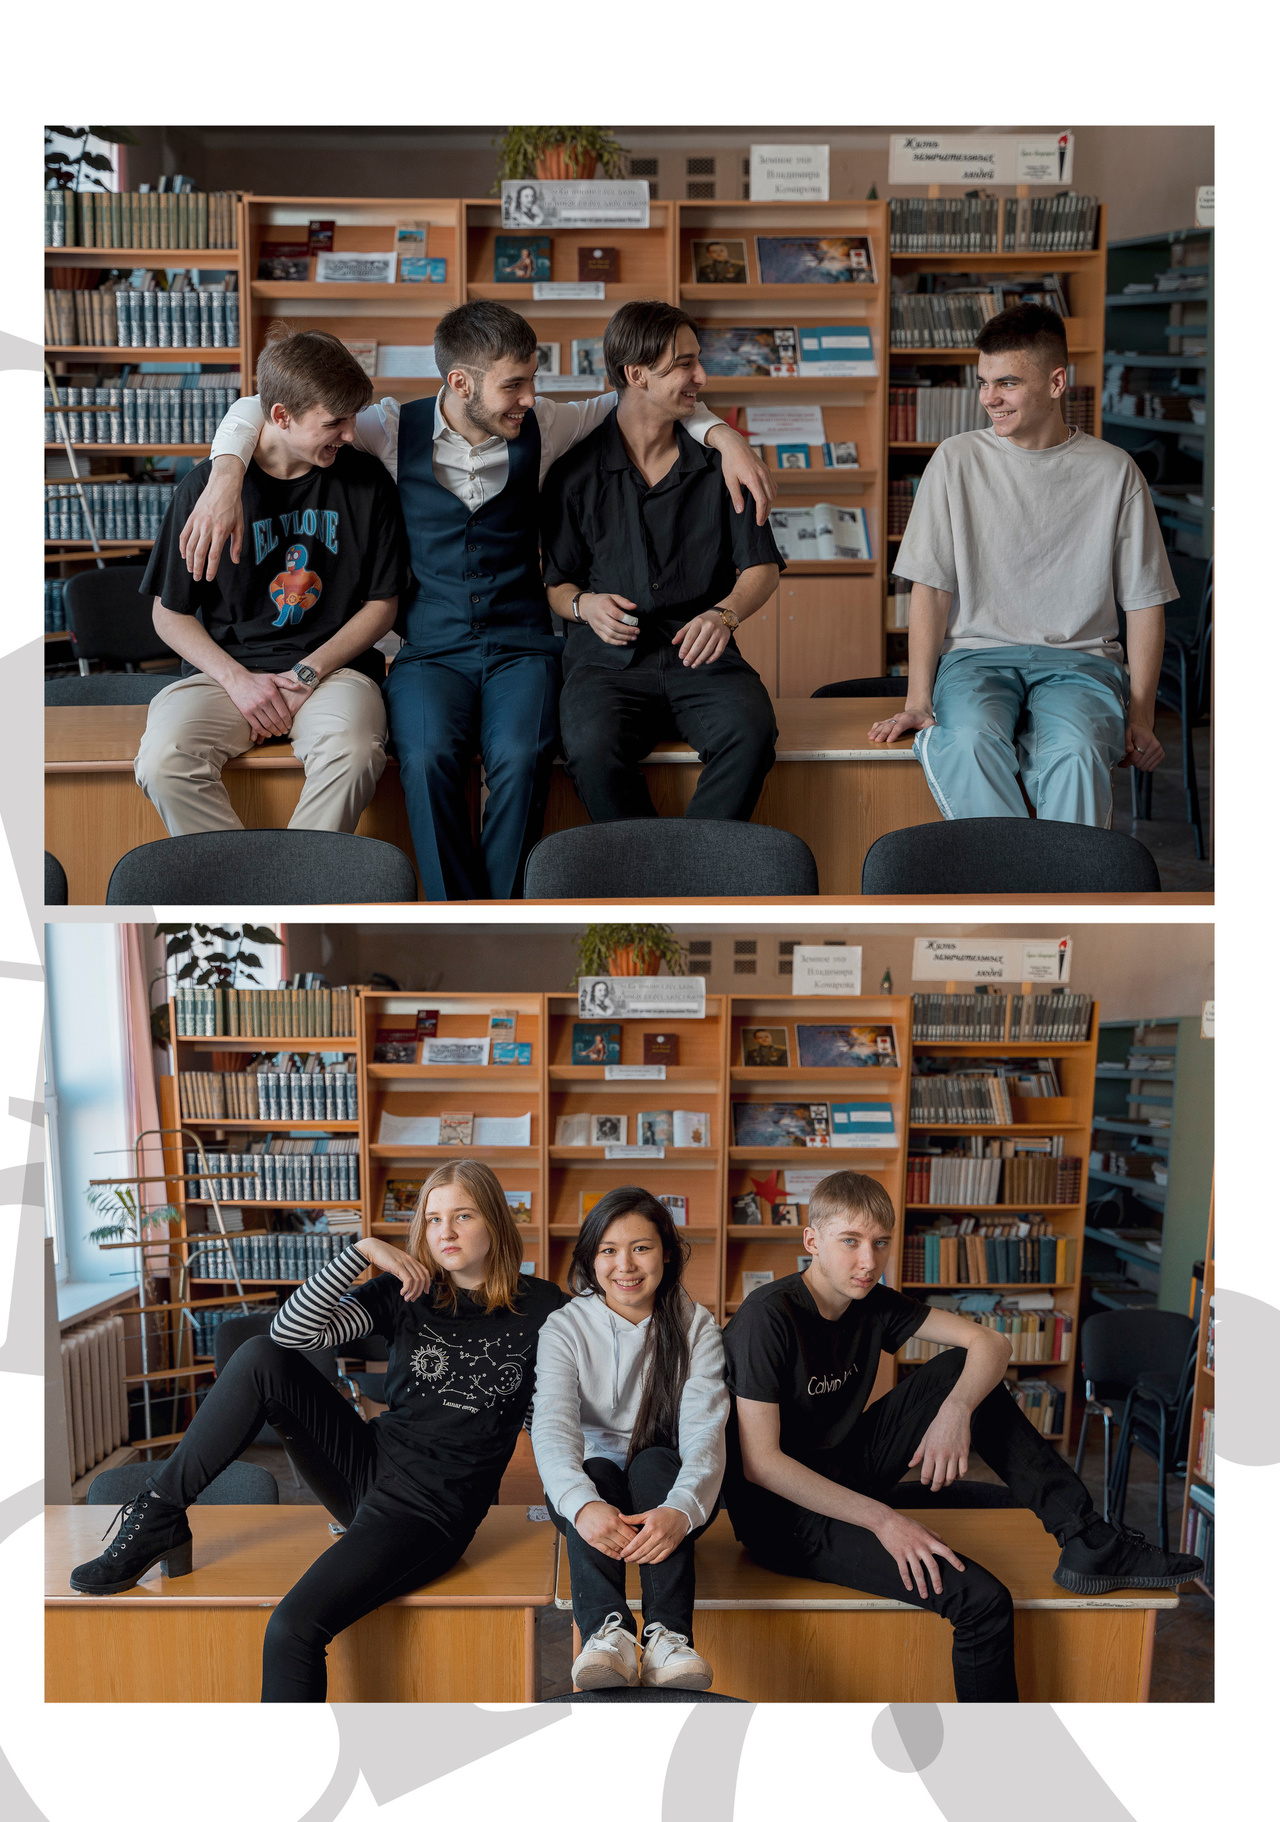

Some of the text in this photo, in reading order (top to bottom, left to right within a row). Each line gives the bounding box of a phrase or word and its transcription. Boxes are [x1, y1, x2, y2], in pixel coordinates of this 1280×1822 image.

[253, 508, 339, 566] EL VLONE
[807, 1373, 842, 1396] Calvin
